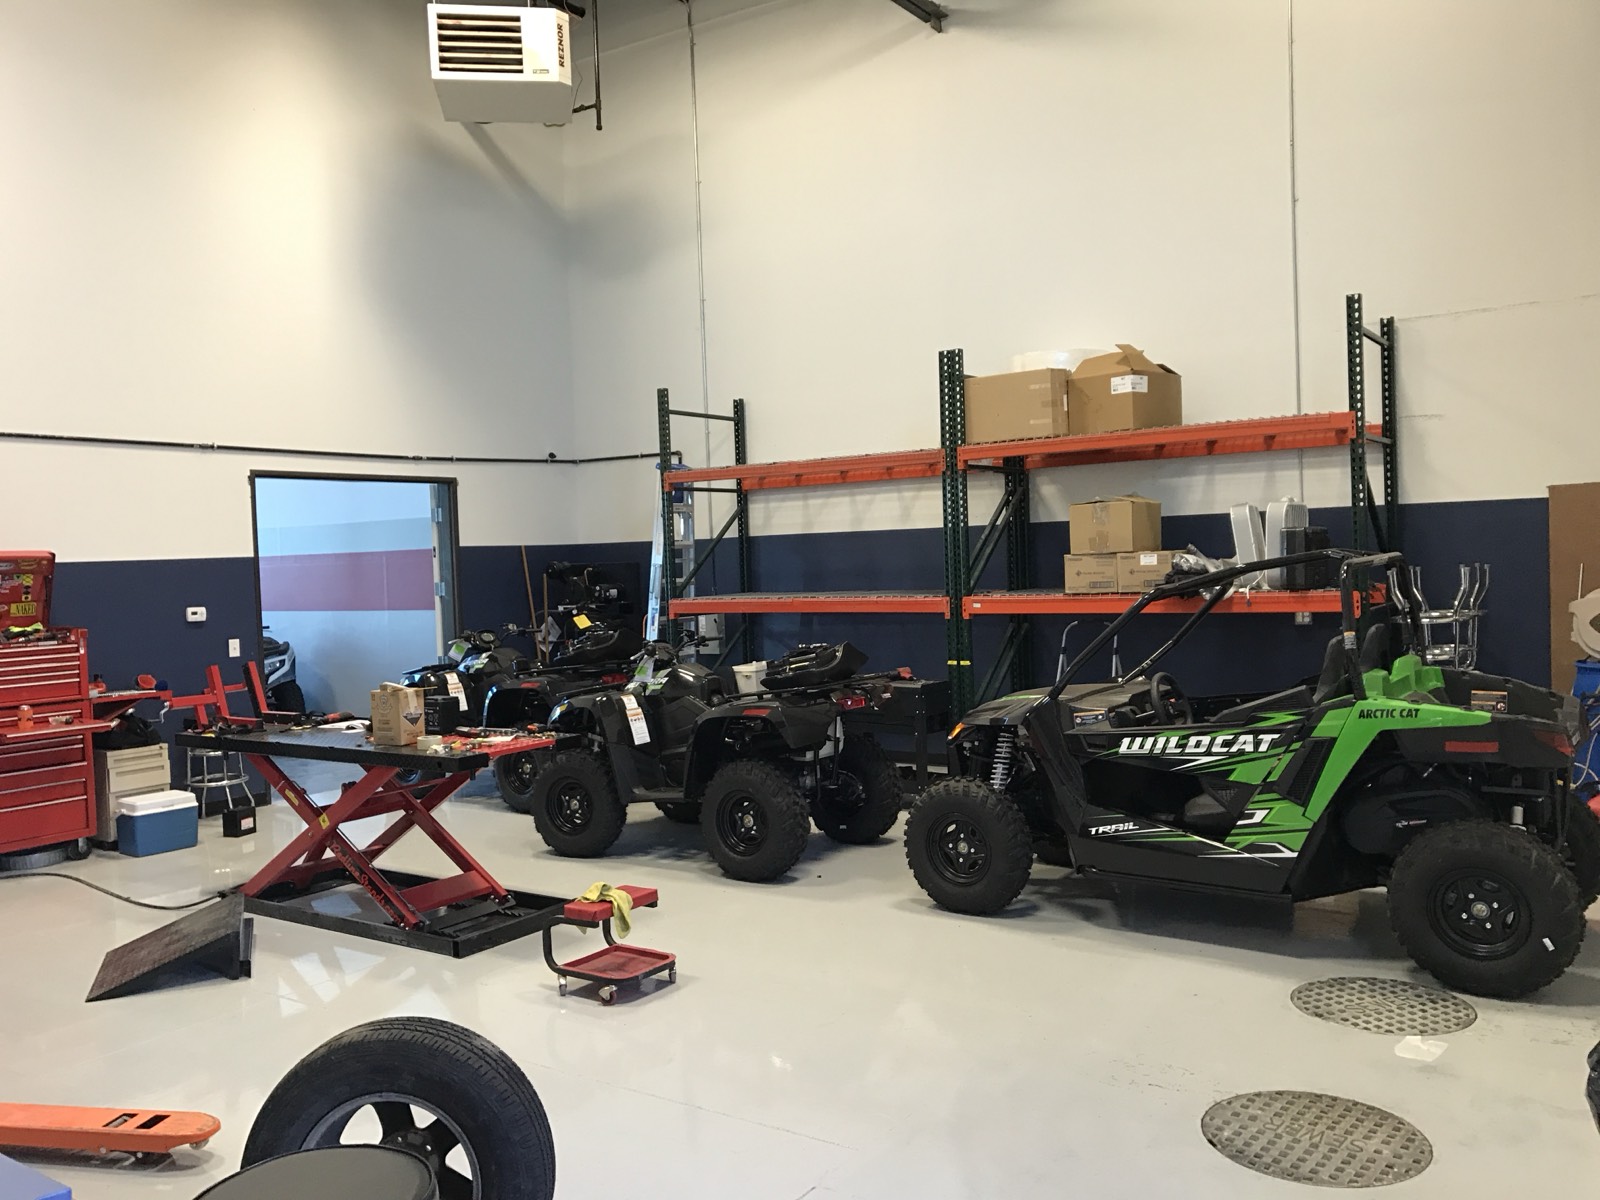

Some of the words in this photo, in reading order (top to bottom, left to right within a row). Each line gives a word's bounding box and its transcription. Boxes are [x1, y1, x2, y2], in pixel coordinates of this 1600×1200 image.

[557, 23, 565, 67] REZNOR
[1358, 708, 1396, 720] ARCTIC
[1400, 708, 1420, 719] CAT
[1118, 733, 1281, 755] WILDCAT
[1088, 821, 1140, 836] TRAIL
[1344, 994, 1416, 1013] SEWER
[1263, 1117, 1368, 1152] SEWER
